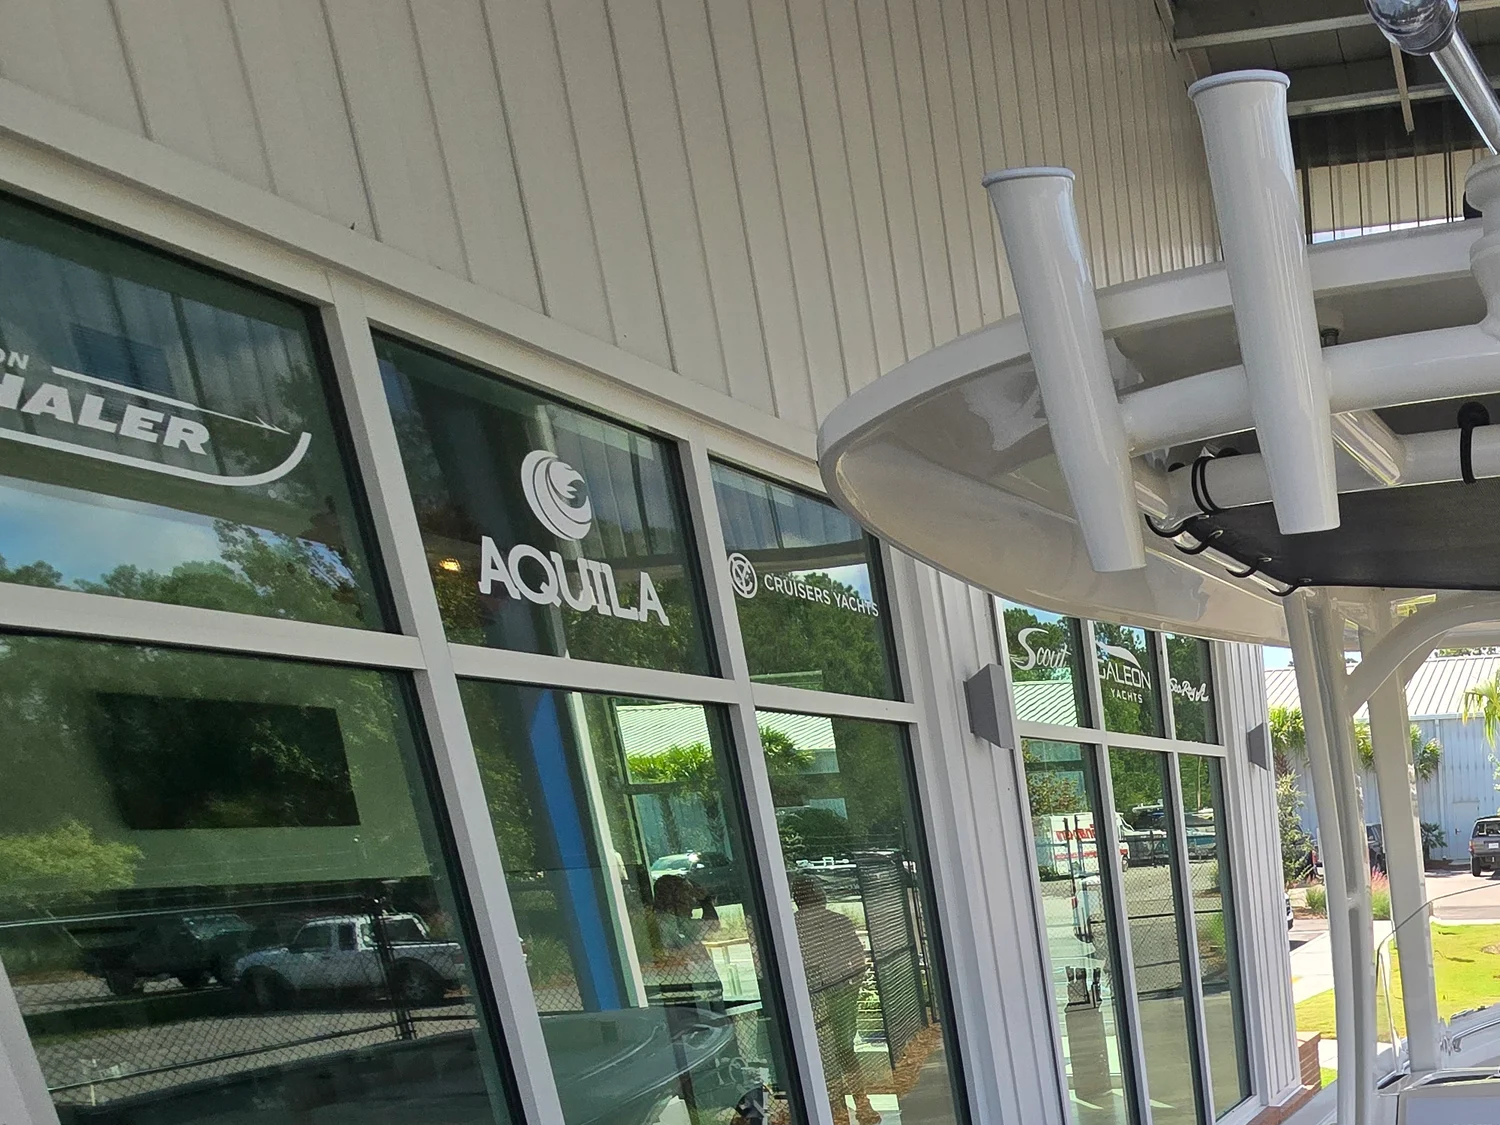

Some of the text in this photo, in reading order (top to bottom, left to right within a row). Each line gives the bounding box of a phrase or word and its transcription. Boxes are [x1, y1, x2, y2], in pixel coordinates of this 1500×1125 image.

[478, 535, 670, 627] AQUILA
[764, 572, 880, 618] CRUISERS YACHTS
[1009, 627, 1072, 671] Scout
[1110, 687, 1144, 704] YACHTS
